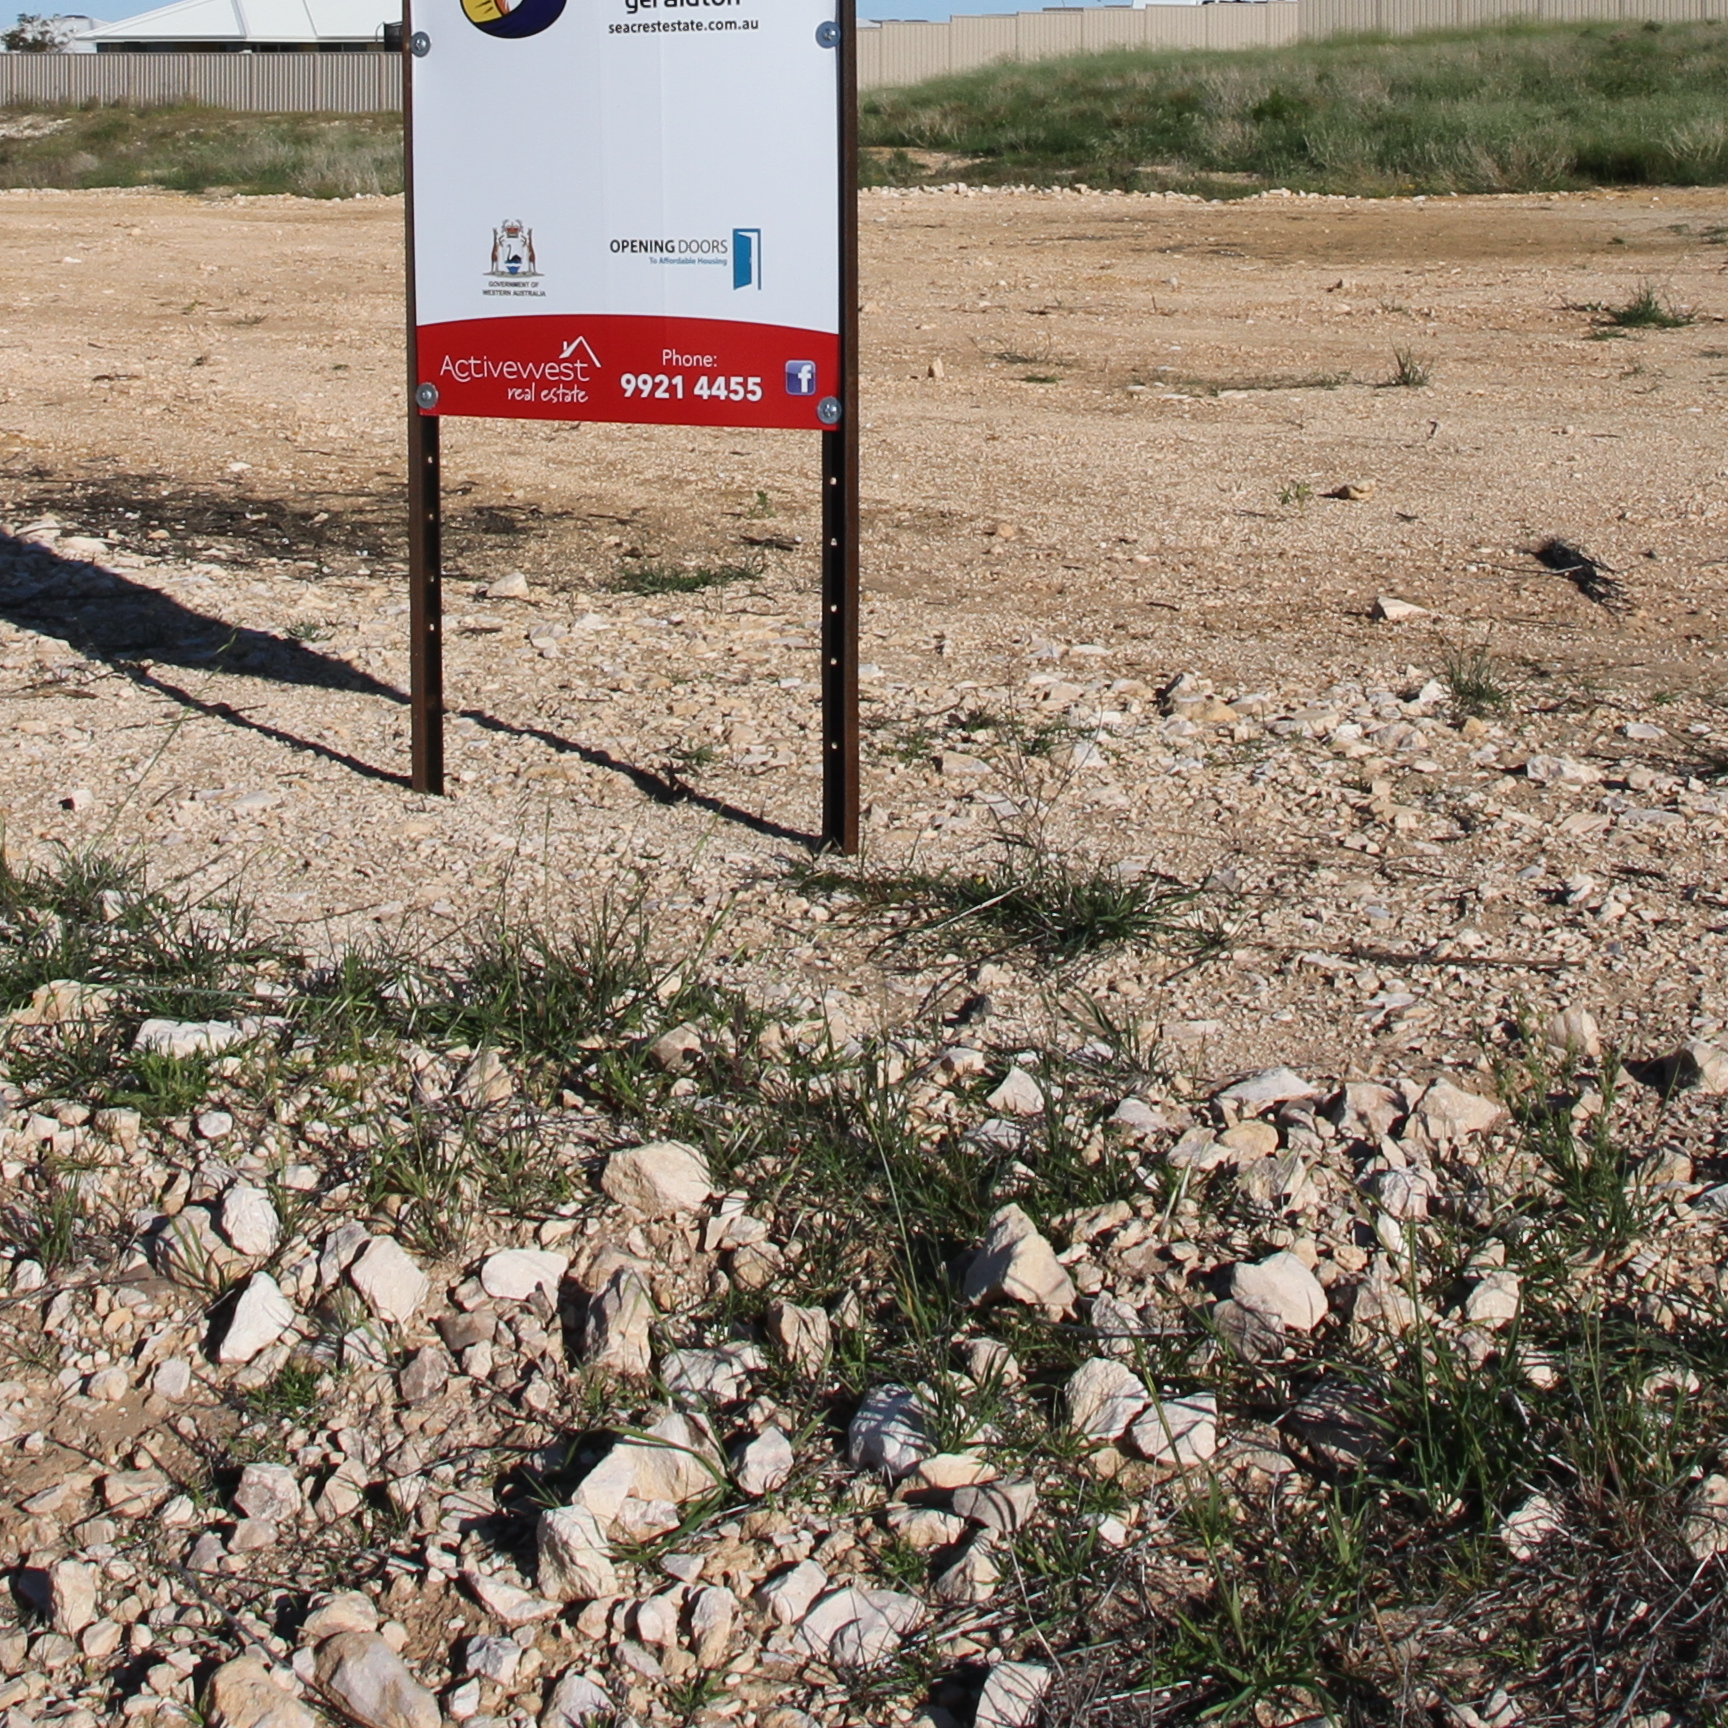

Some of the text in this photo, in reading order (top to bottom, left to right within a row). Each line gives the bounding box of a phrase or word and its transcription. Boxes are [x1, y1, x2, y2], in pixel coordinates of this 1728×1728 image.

[608, 20, 759, 34] seacrestestate.com.au
[610, 239, 728, 254] OPENING DOORS
[659, 257, 696, 265] Affordable
[697, 257, 728, 266] Housing
[662, 349, 718, 368] Phone:
[439, 355, 591, 383] Activewest
[507, 382, 589, 403] real estate
[620, 373, 763, 402] 9921 4455
